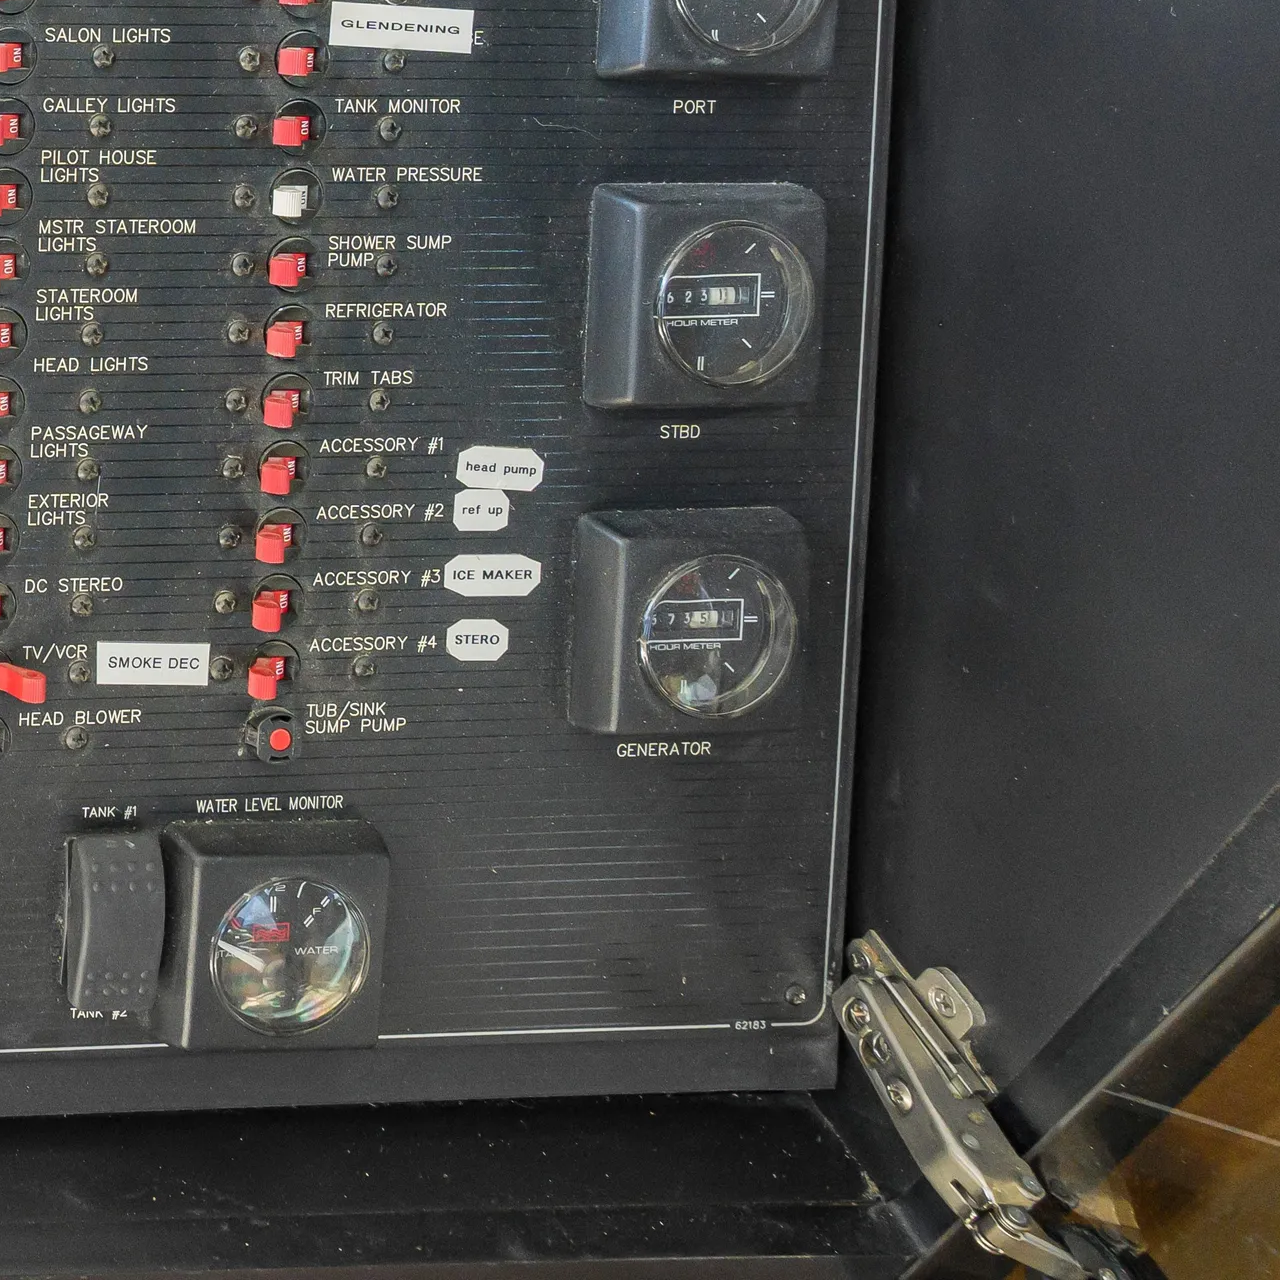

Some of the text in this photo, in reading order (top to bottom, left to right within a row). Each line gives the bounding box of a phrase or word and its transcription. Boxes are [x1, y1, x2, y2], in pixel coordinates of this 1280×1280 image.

[340, 19, 460, 35] GLENDENING
[672, 99, 717, 115] PORT
[325, 302, 448, 318] REFRIGERATOR
[465, 461, 537, 478] head pump
[28, 492, 109, 509] EXTERIOR
[452, 569, 533, 581] ICE MAKER
[22, 642, 88, 664] TV/VCR
[108, 656, 200, 670] SMOKE DEC
[306, 700, 387, 721] TUB/SINK
[616, 741, 712, 758] GENERATOR
[196, 794, 344, 814] WATER LEVEL MONITOR
[734, 1020, 767, 1031] 62183
